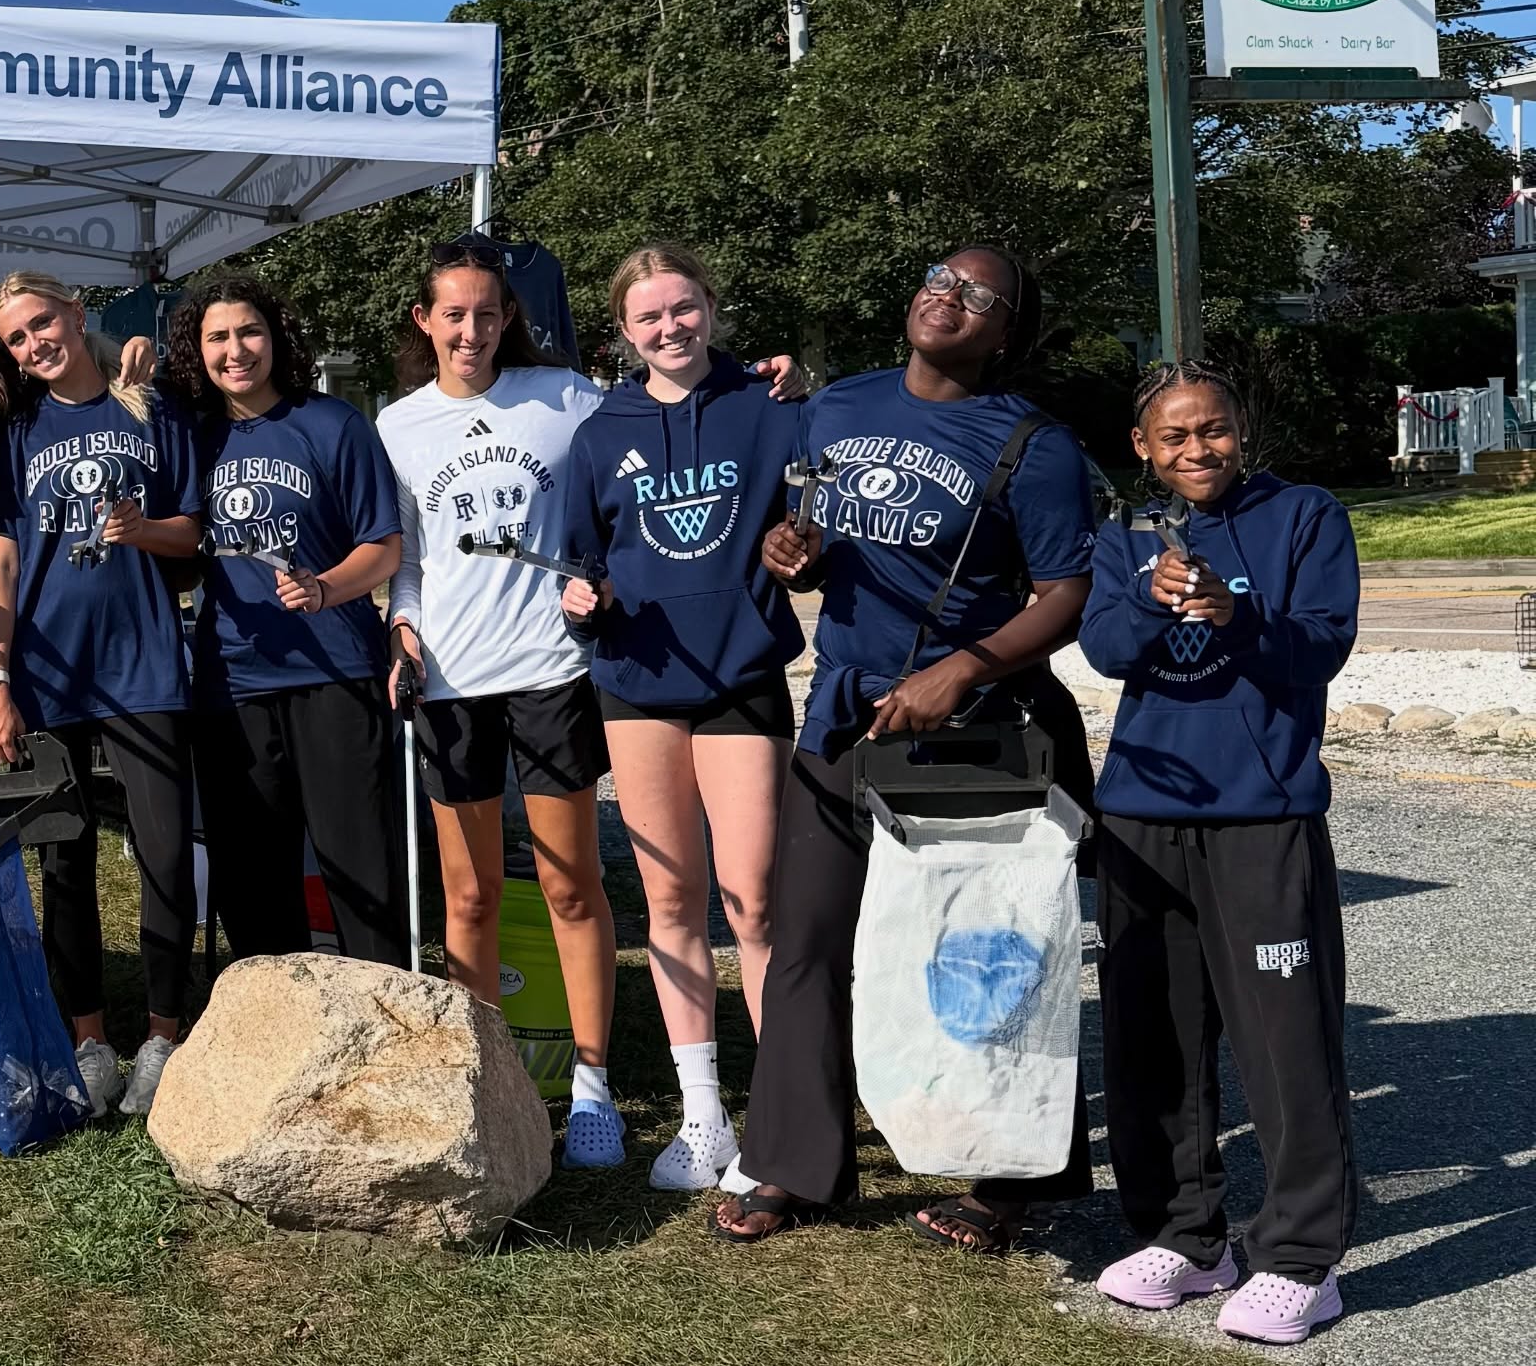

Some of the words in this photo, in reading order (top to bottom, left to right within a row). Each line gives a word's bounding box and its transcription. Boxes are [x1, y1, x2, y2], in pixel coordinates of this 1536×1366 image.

[1246, 35, 1274, 48] Clam
[1278, 35, 1313, 49] Shack
[1341, 36, 1372, 51] Dairy
[1376, 36, 1396, 49] Bar
[207, 51, 448, 118] Alliance
[26, 437, 81, 497] RHODE
[85, 431, 158, 472] ISLAND
[242, 457, 311, 499] ISLAND
[426, 462, 460, 513] RHODE
[458, 445, 517, 471] ISLAND
[518, 452, 555, 493] RAMS
[632, 460, 739, 505] RAMS
[892, 440, 975, 506] ISLAND
[811, 485, 942, 547] RAMS
[694, 539, 721, 558] ISLAND
[1158, 670, 1188, 682] RHODE
[1189, 663, 1218, 682] ISLAND
[1256, 940, 1308, 957] RHODY
[1257, 951, 1310, 969] HOOPS
[499, 973, 522, 983] RCA
